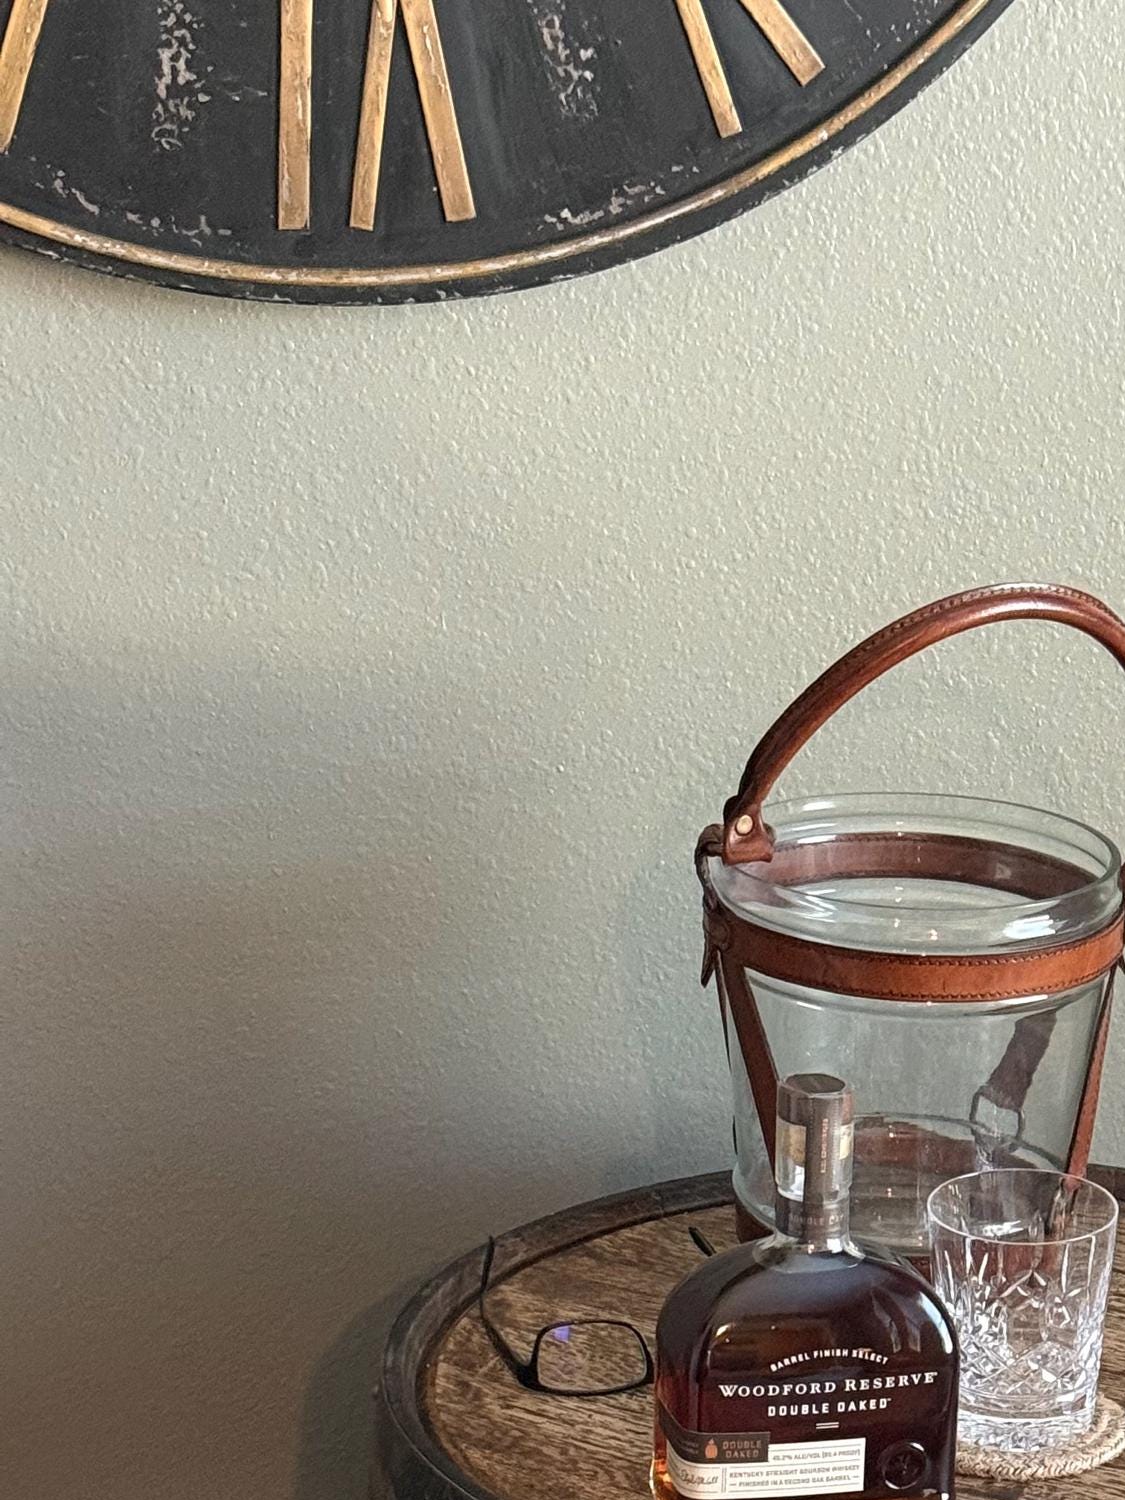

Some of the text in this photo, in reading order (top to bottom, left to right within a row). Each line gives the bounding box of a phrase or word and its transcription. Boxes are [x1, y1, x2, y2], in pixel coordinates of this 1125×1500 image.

[770, 1348, 889, 1372] BARREL FINISH SELECT
[718, 1381, 836, 1398] WOODFORD
[767, 1398, 888, 1417] DOUBLE OAKED
[722, 1440, 762, 1458] DOUBLE OAKED
